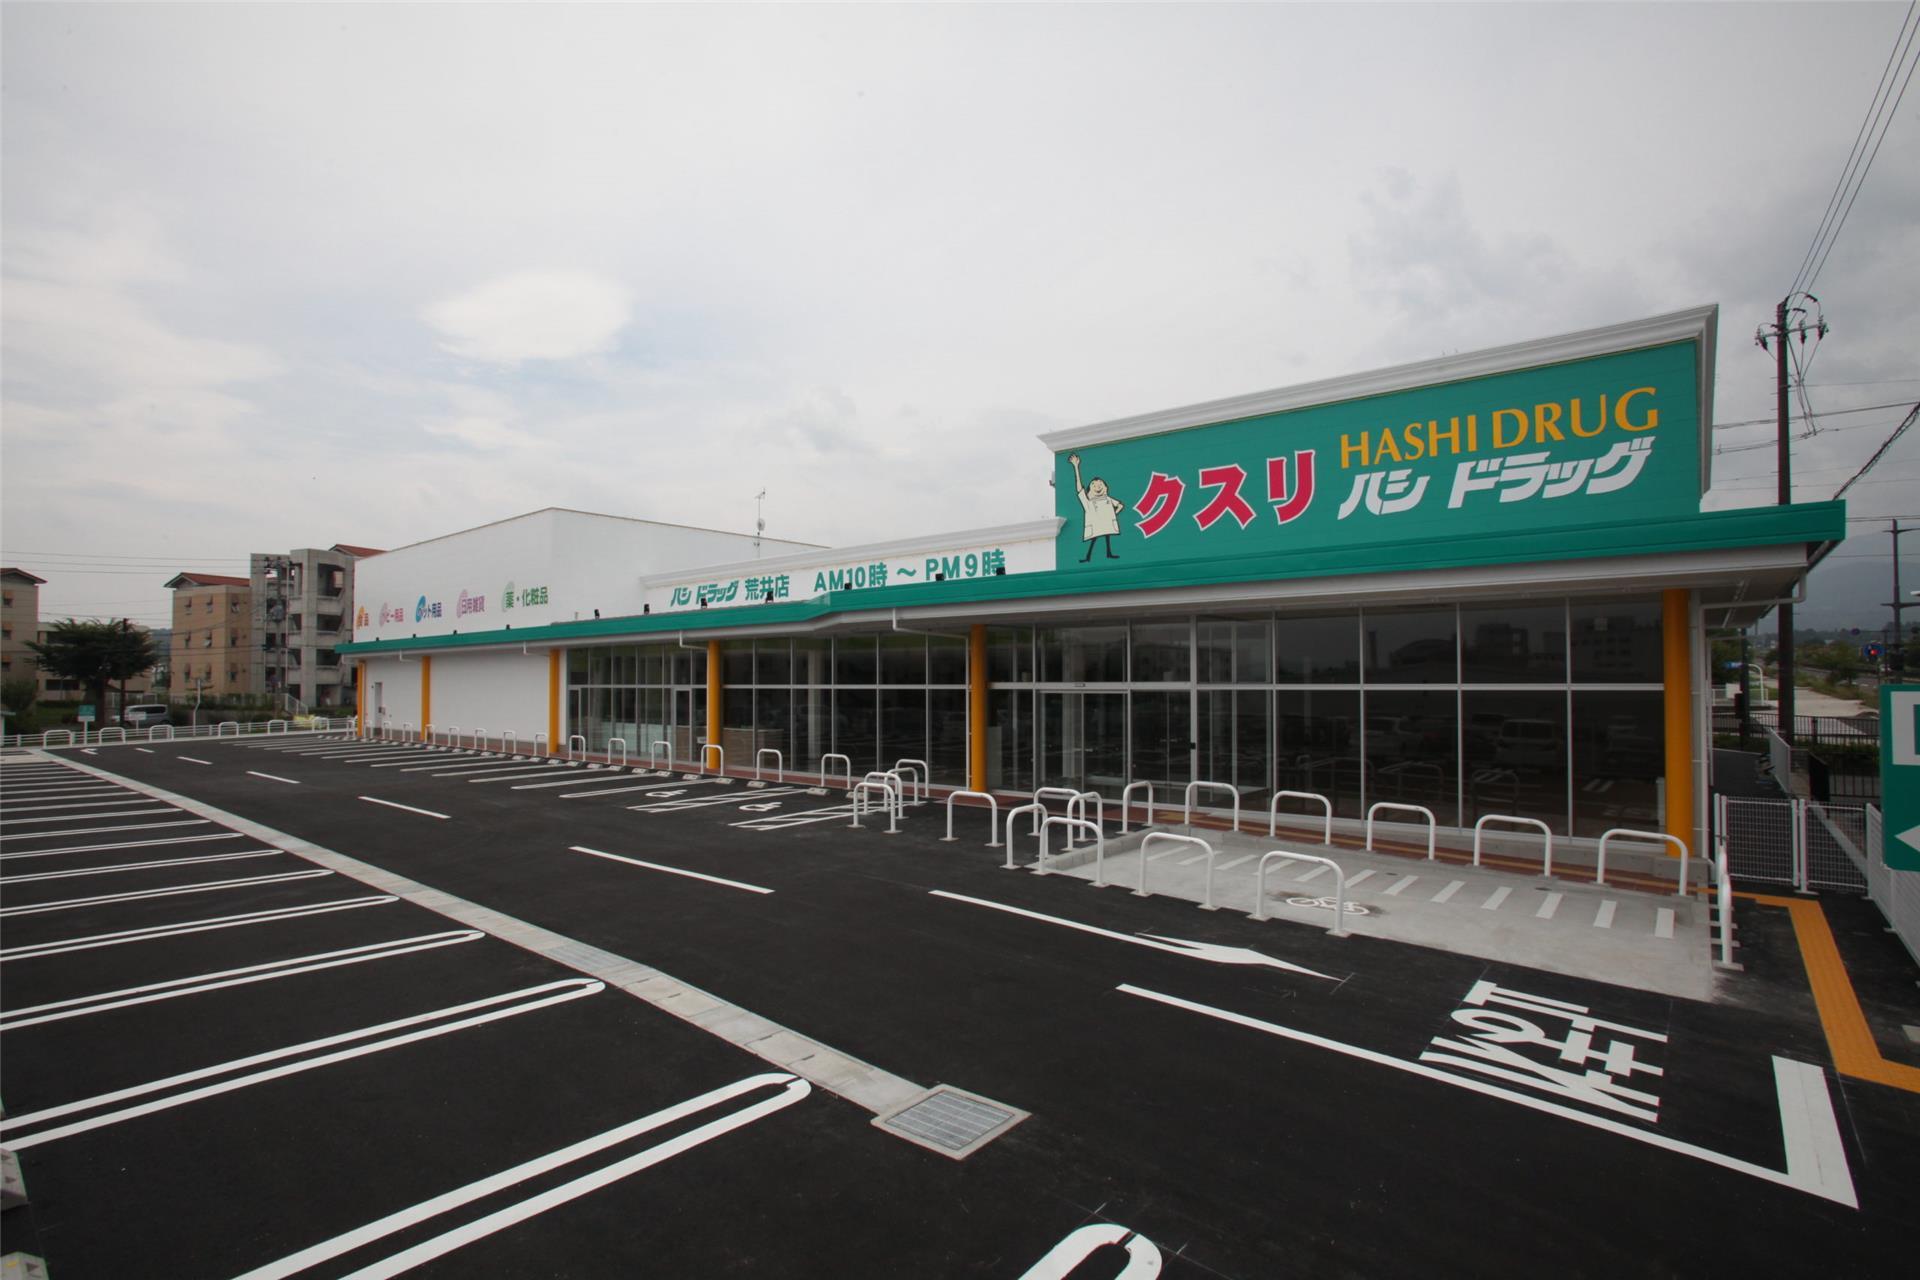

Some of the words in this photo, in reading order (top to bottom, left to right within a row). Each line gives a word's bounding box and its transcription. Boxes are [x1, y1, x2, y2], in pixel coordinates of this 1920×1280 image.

[1341, 414, 1478, 468] HASHI
[1491, 386, 1658, 449] DRUG
[1134, 450, 1317, 538] クスリ
[1446, 436, 1656, 510] ドラッグ
[744, 574, 790, 601] 荒井店
[1418, 979, 1669, 1123] 止まれ
